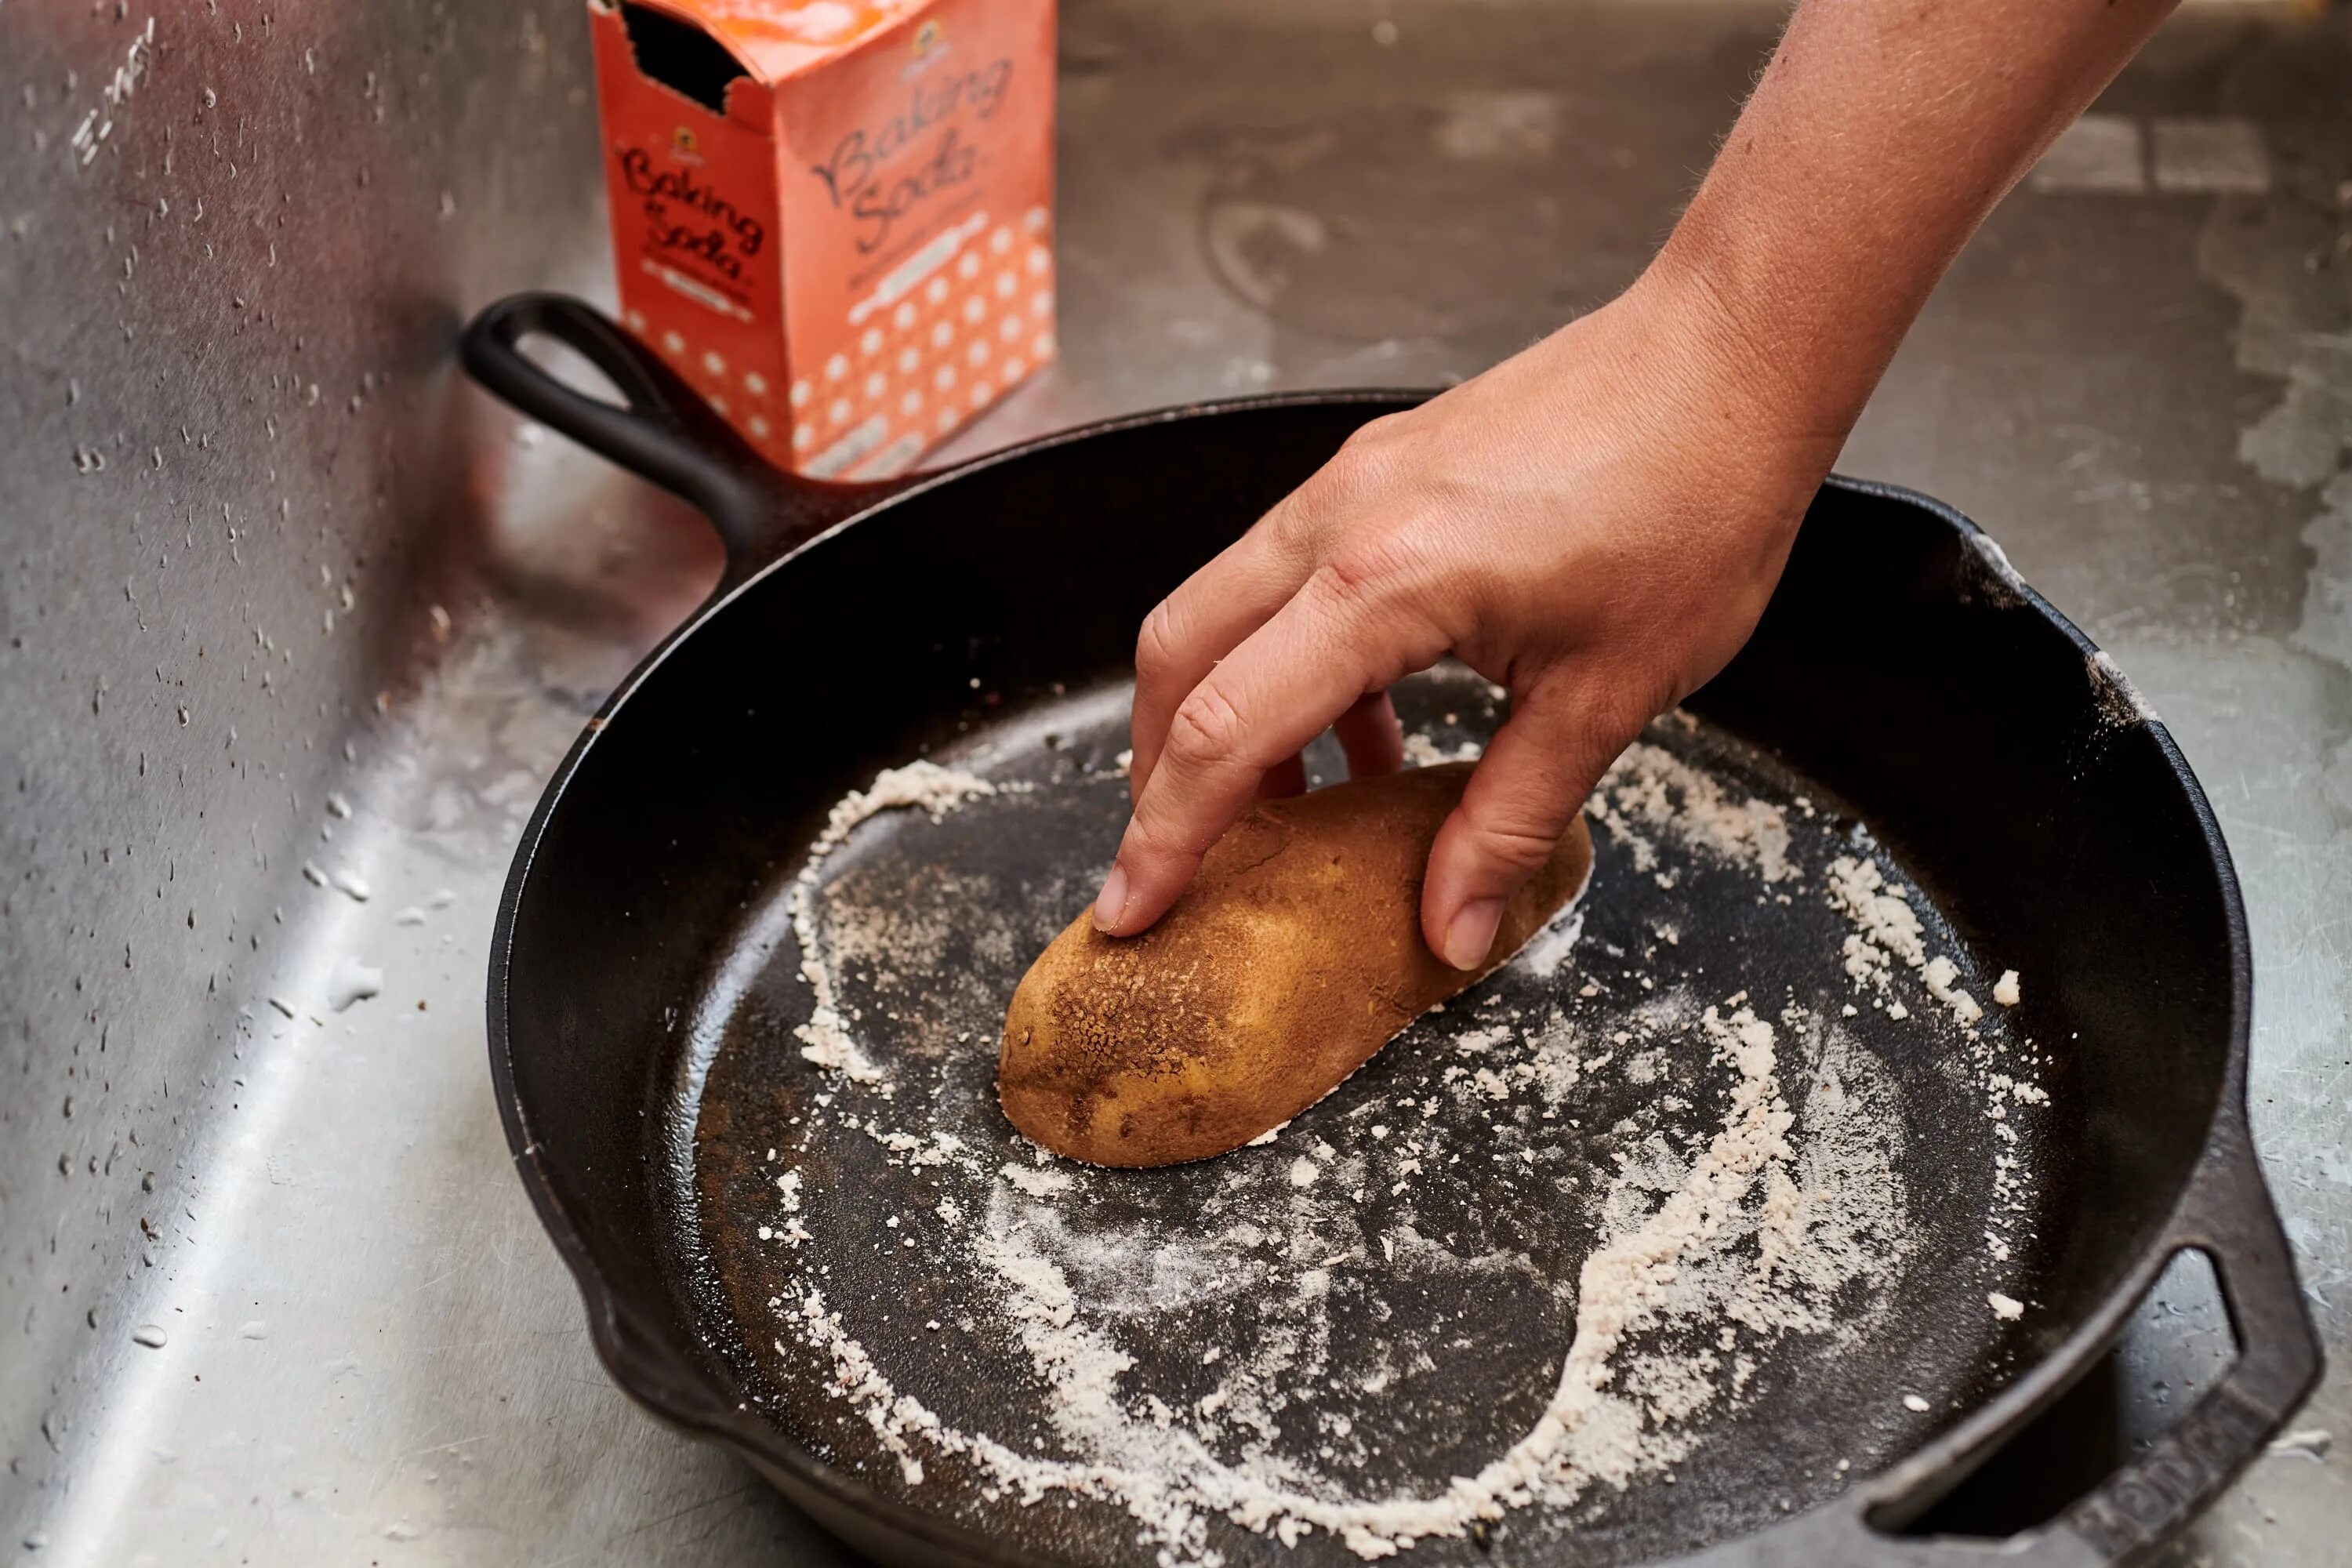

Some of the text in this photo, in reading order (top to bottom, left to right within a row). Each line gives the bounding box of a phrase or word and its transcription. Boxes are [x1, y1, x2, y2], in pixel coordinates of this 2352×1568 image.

[811, 56, 1014, 209] Baking
[851, 127, 977, 256] Soda
[617, 147, 764, 257] Baking
[644, 200, 741, 280] Soda
